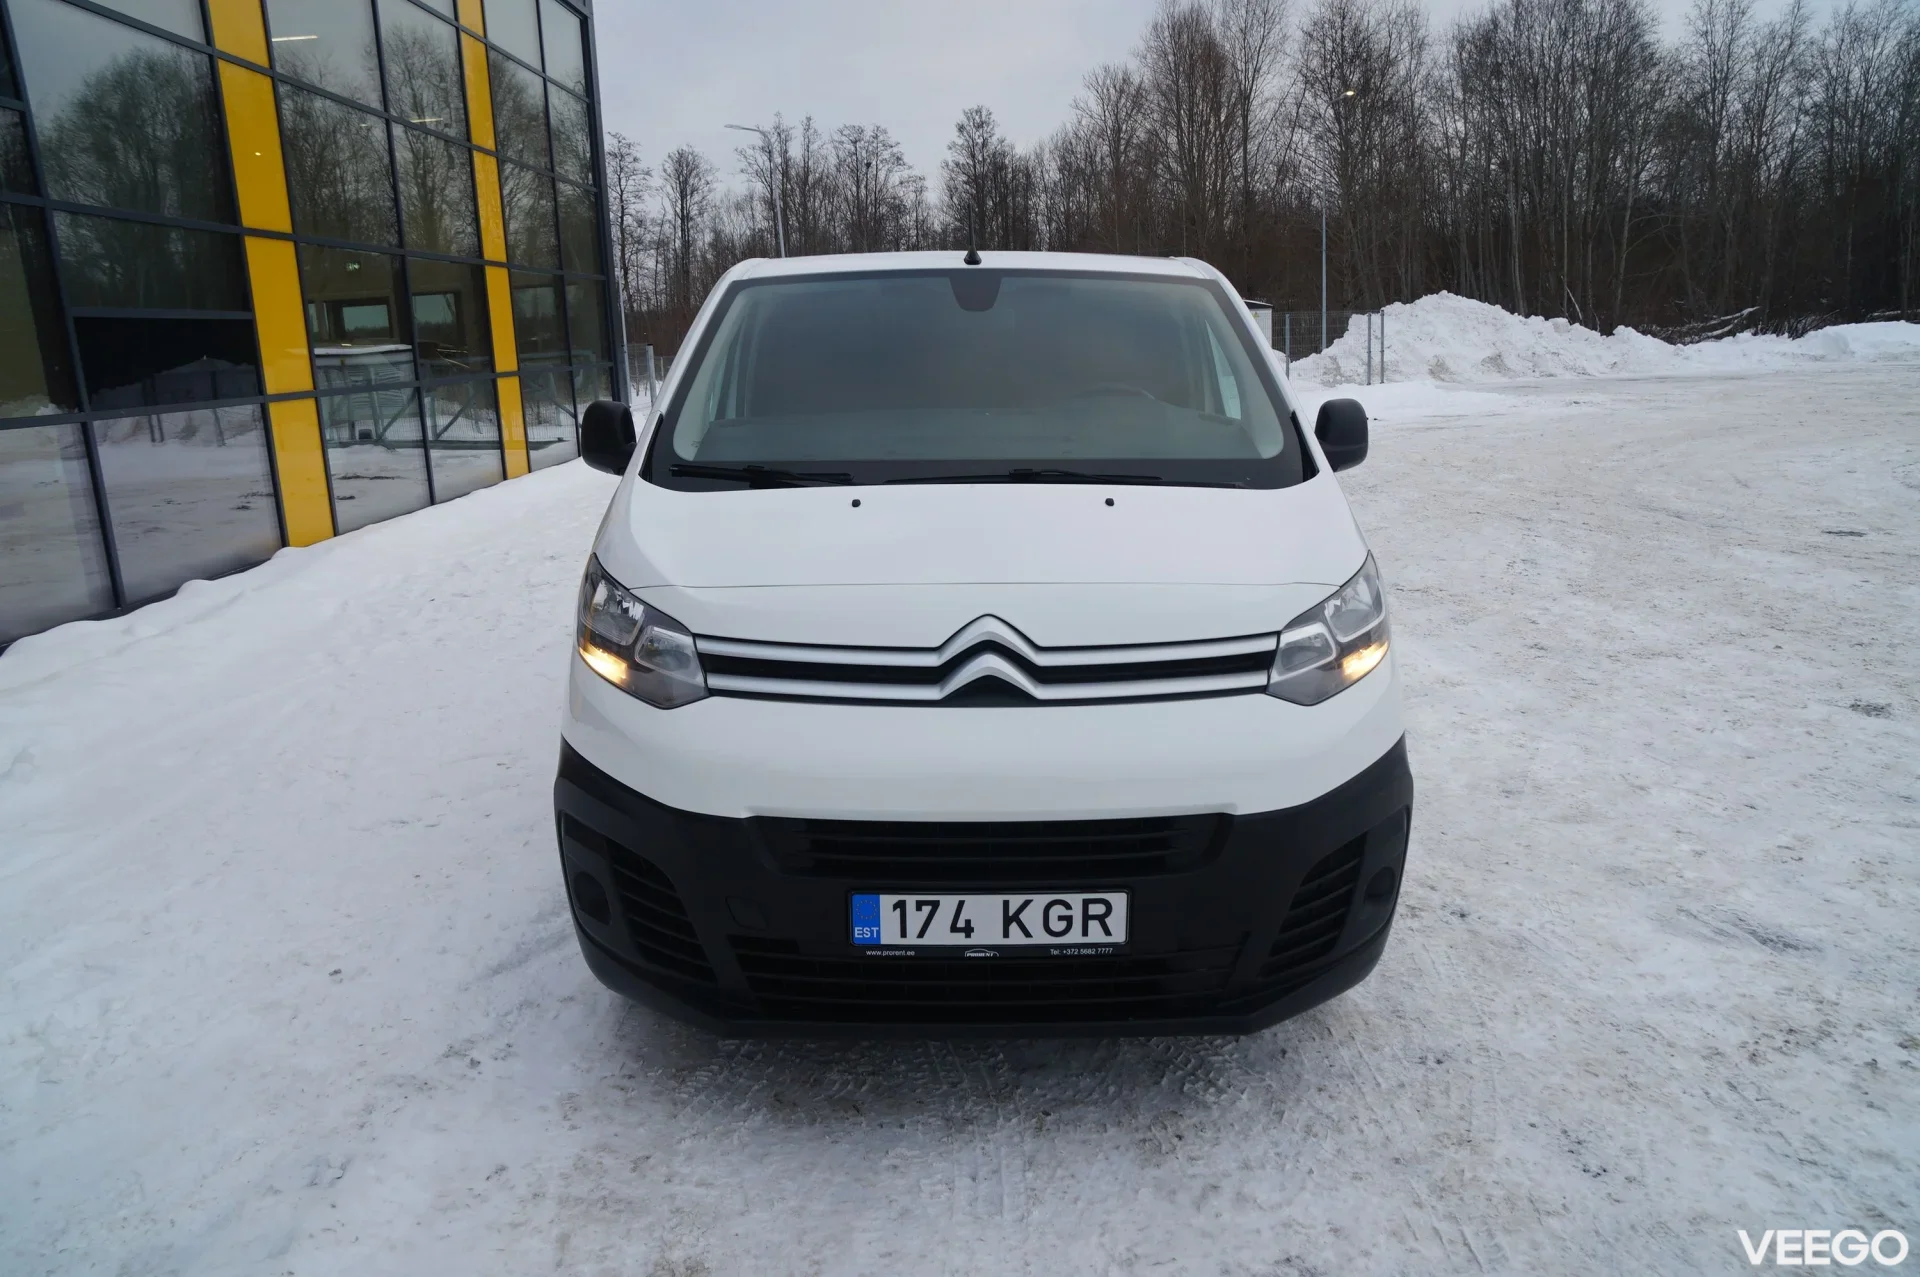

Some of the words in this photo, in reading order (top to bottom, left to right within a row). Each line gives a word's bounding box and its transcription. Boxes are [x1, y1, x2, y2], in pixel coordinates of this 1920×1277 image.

[892, 899, 975, 939] 174
[1002, 897, 1113, 939] KGR
[854, 927, 879, 939] EST
[865, 949, 916, 957] www.prorent.ee
